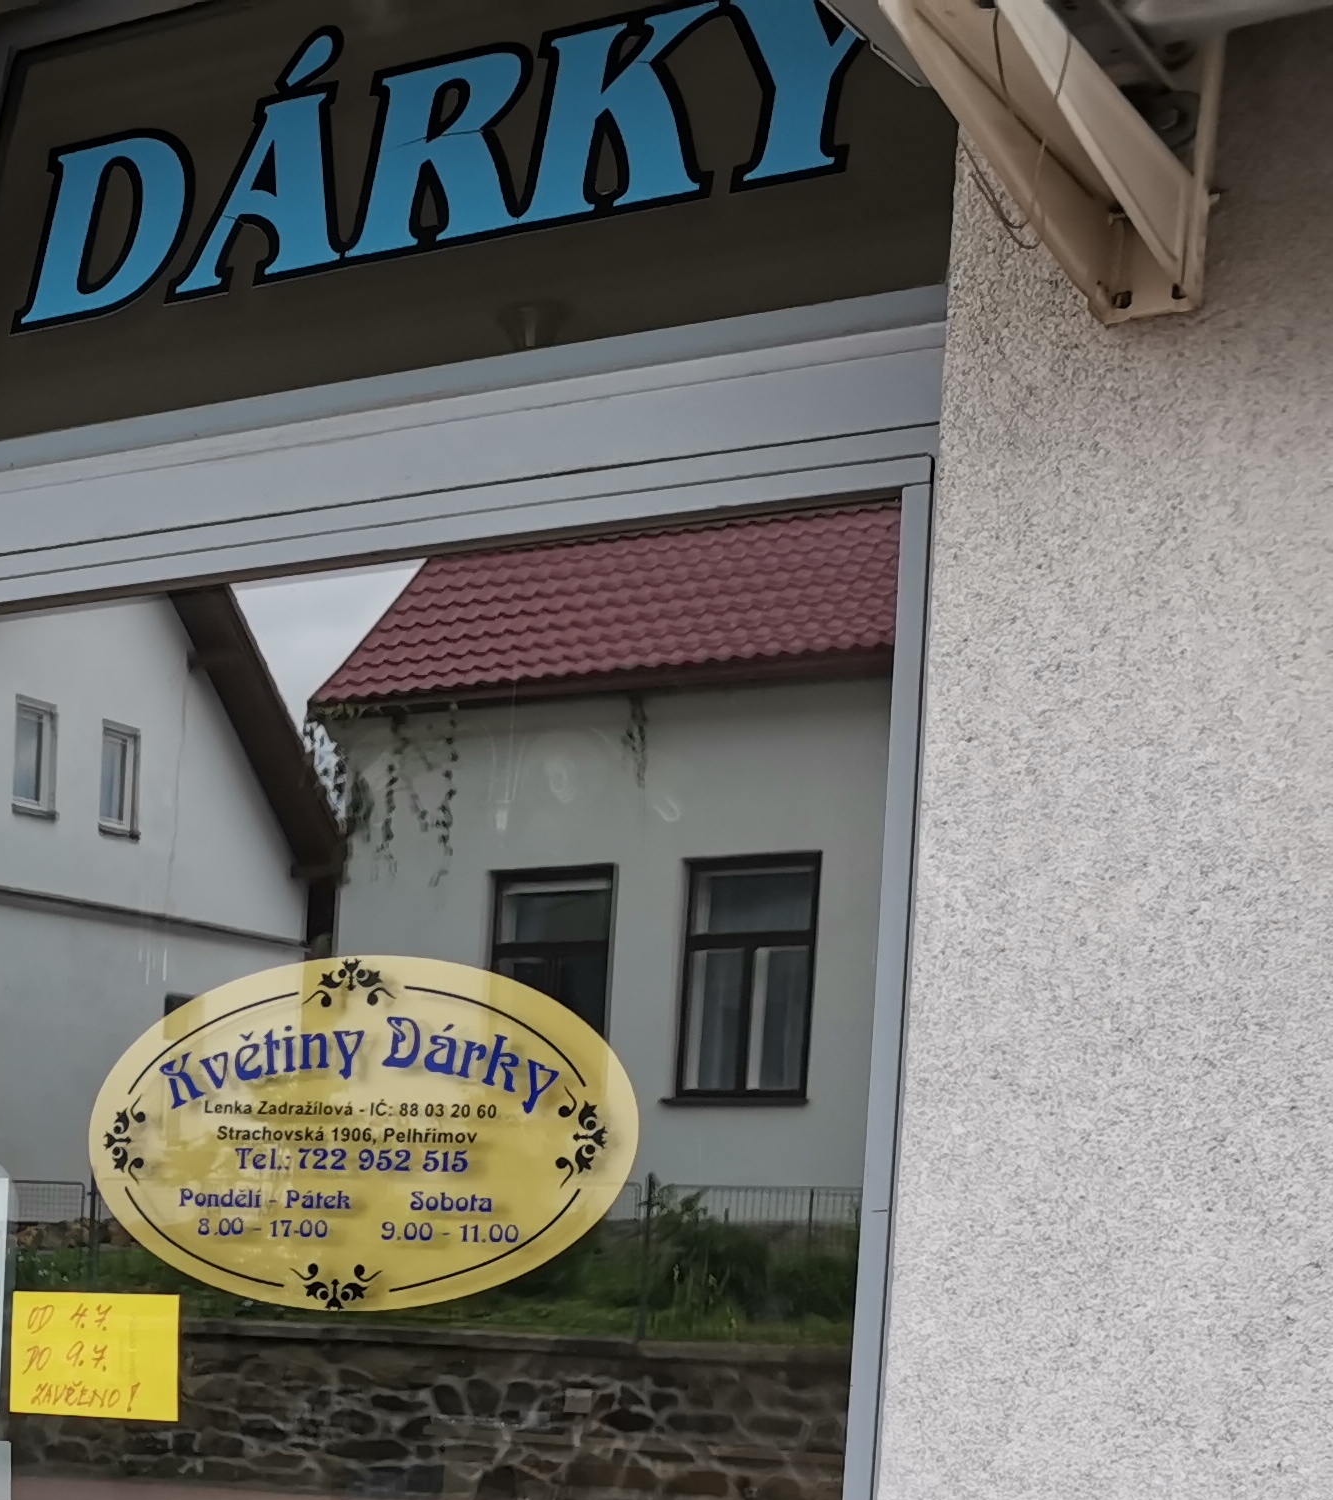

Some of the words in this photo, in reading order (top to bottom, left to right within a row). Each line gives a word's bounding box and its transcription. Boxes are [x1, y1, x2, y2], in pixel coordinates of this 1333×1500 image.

[10, 0, 865, 335] DÁRKY
[159, 1024, 365, 1110] Květiny
[381, 1016, 560, 1113] Dárky
[204, 1100, 253, 1115] Lenka
[398, 1103, 419, 1117] 88
[424, 1103, 445, 1118] 03
[449, 1103, 471, 1118] 20
[476, 1104, 497, 1119] 60
[216, 1125, 324, 1142] Strachovská
[332, 1127, 377, 1145] 1906,
[383, 1126, 478, 1145] Pelhřimov
[235, 1147, 290, 1172] Tel.:
[298, 1147, 347, 1171] 722
[358, 1148, 411, 1172] 952
[422, 1149, 469, 1173] 515
[179, 1187, 262, 1209] Pondělí
[285, 1189, 351, 1210] Pátek
[410, 1191, 493, 1213] Sobota
[197, 1217, 244, 1236] 8.00
[381, 1222, 433, 1242] 9.00
[459, 1223, 520, 1243] 11.00
[27, 1304, 55, 1334] OD
[22, 1345, 52, 1375] DO
